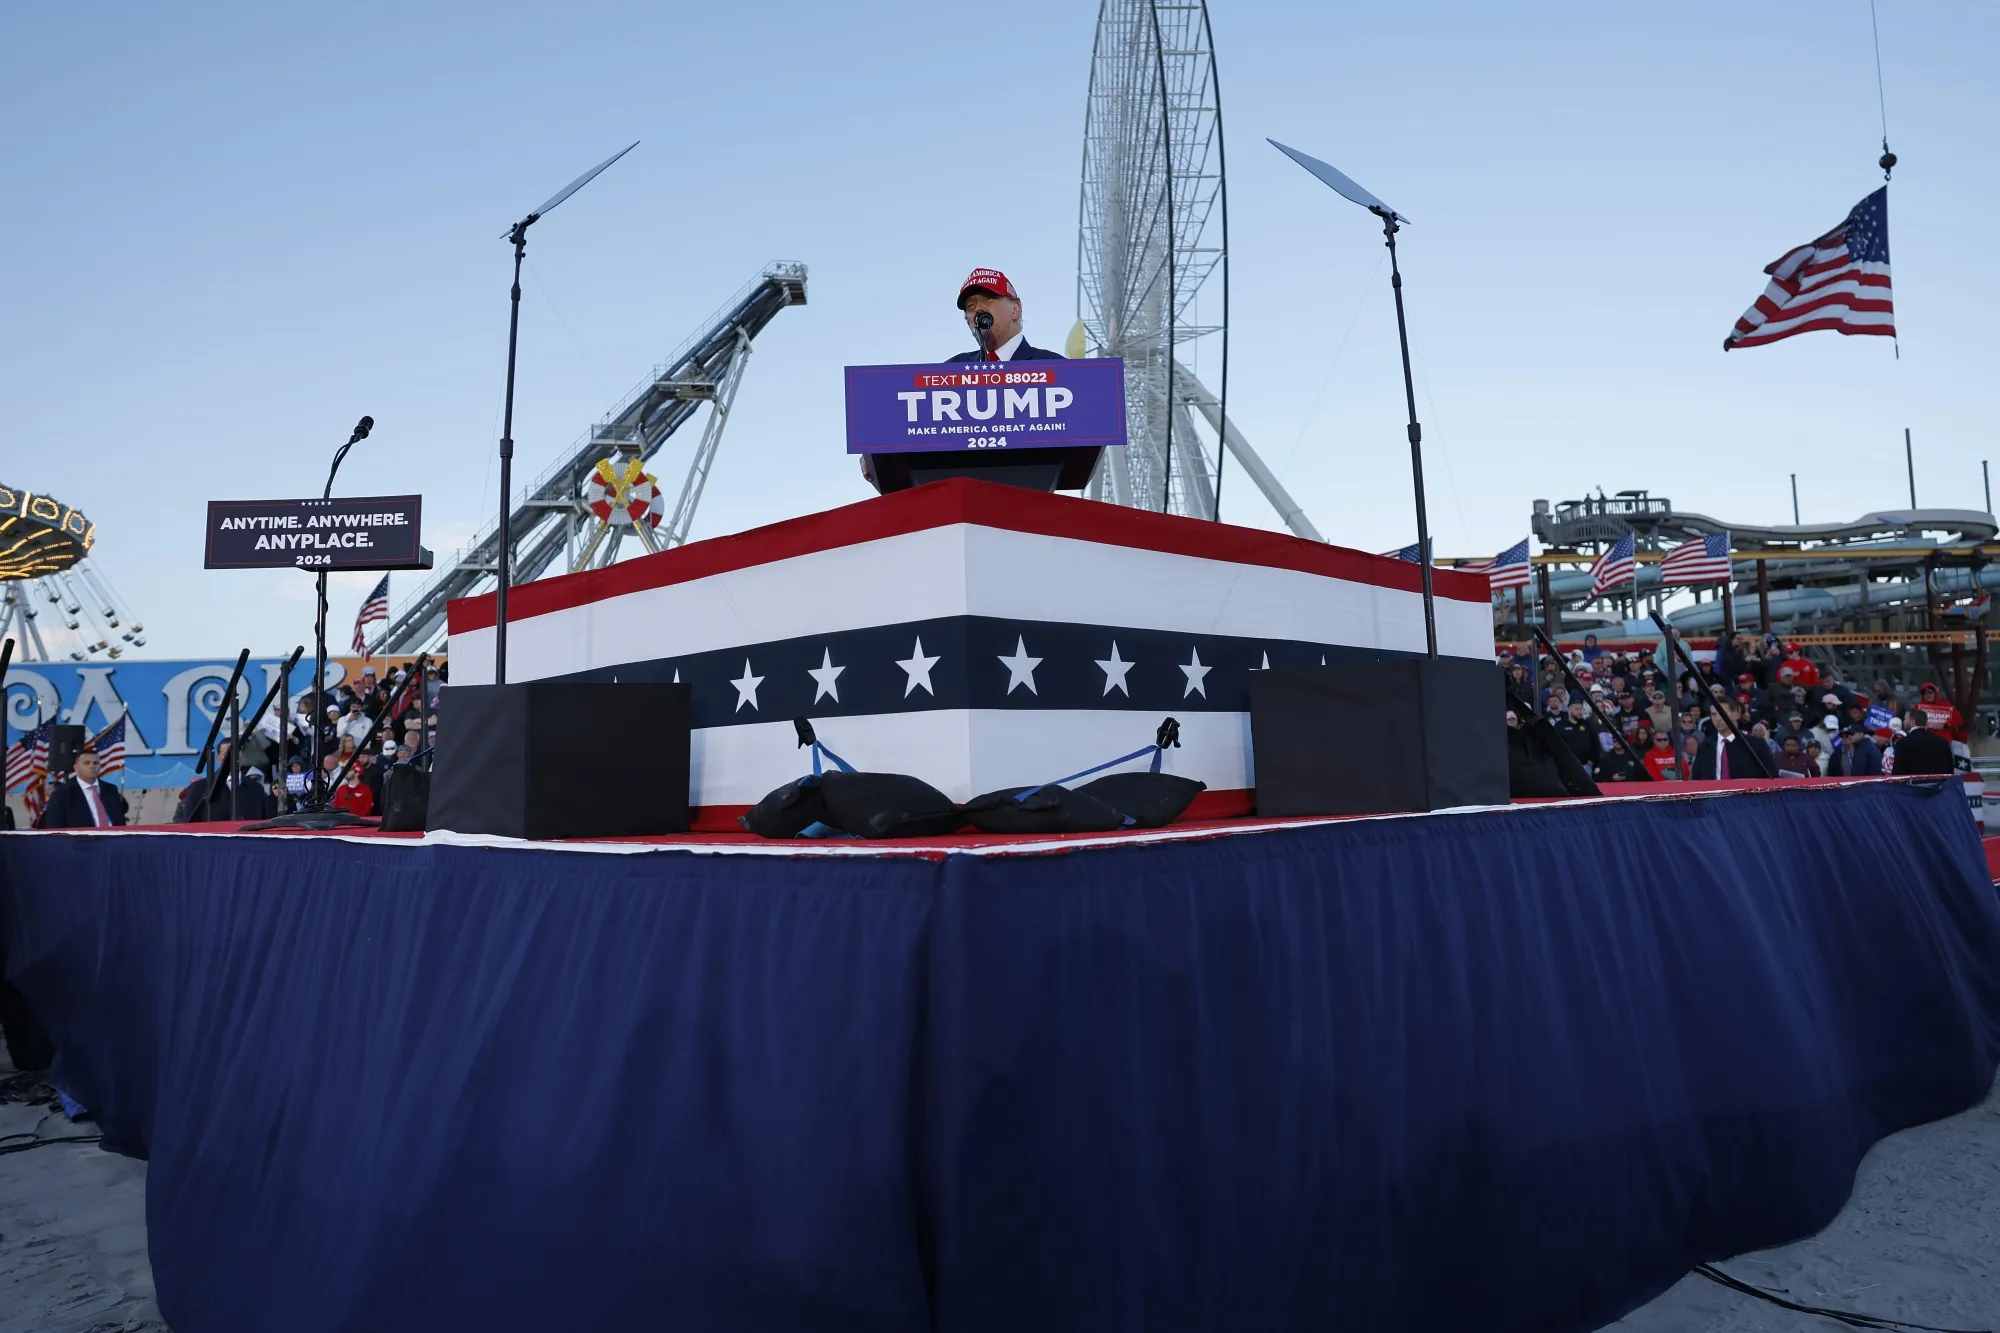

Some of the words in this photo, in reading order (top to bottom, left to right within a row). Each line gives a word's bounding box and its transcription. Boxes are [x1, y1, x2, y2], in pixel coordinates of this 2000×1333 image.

[972, 270, 1001, 278] AMERICA
[977, 277, 998, 285] AGAIN
[922, 375, 958, 386] TEXT
[961, 374, 979, 385] NJ
[982, 373, 1001, 385] TO
[1004, 372, 1048, 384] 88022
[897, 386, 1074, 422] TRUMP
[907, 427, 938, 436] MAKE
[940, 425, 988, 435] AMERICA
[991, 424, 1026, 433] GREAT
[1028, 422, 1066, 432] AGAIN!
[967, 436, 1008, 449] 2024
[219, 515, 303, 530] ANYTIME.
[305, 512, 409, 528] ANYWHERE.
[253, 531, 374, 550] ANYPLACE.
[295, 554, 332, 566] 2024
